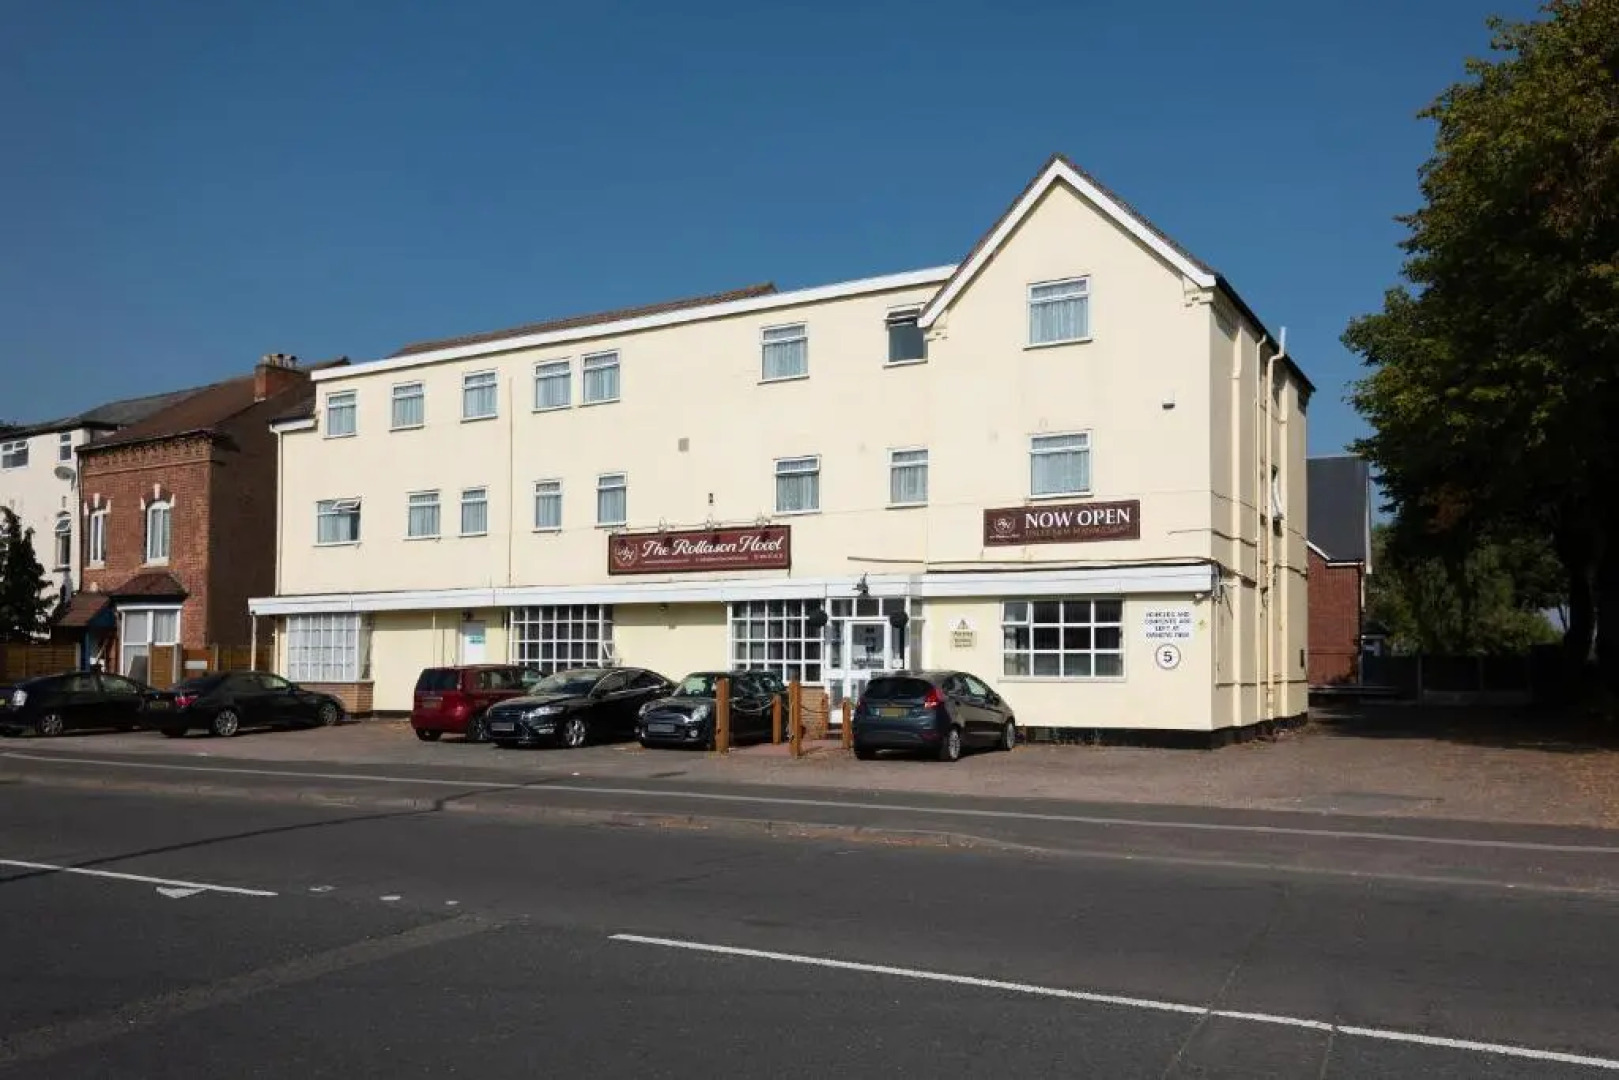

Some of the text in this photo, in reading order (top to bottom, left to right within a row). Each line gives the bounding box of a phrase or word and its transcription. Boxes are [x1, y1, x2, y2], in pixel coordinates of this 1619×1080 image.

[1025, 511, 1072, 528] NOW
[1077, 508, 1131, 525] OPEN
[642, 540, 670, 558] The
[672, 539, 737, 555] Rollason
[739, 535, 784, 552] Hotel
[1163, 651, 1172, 663] 5
